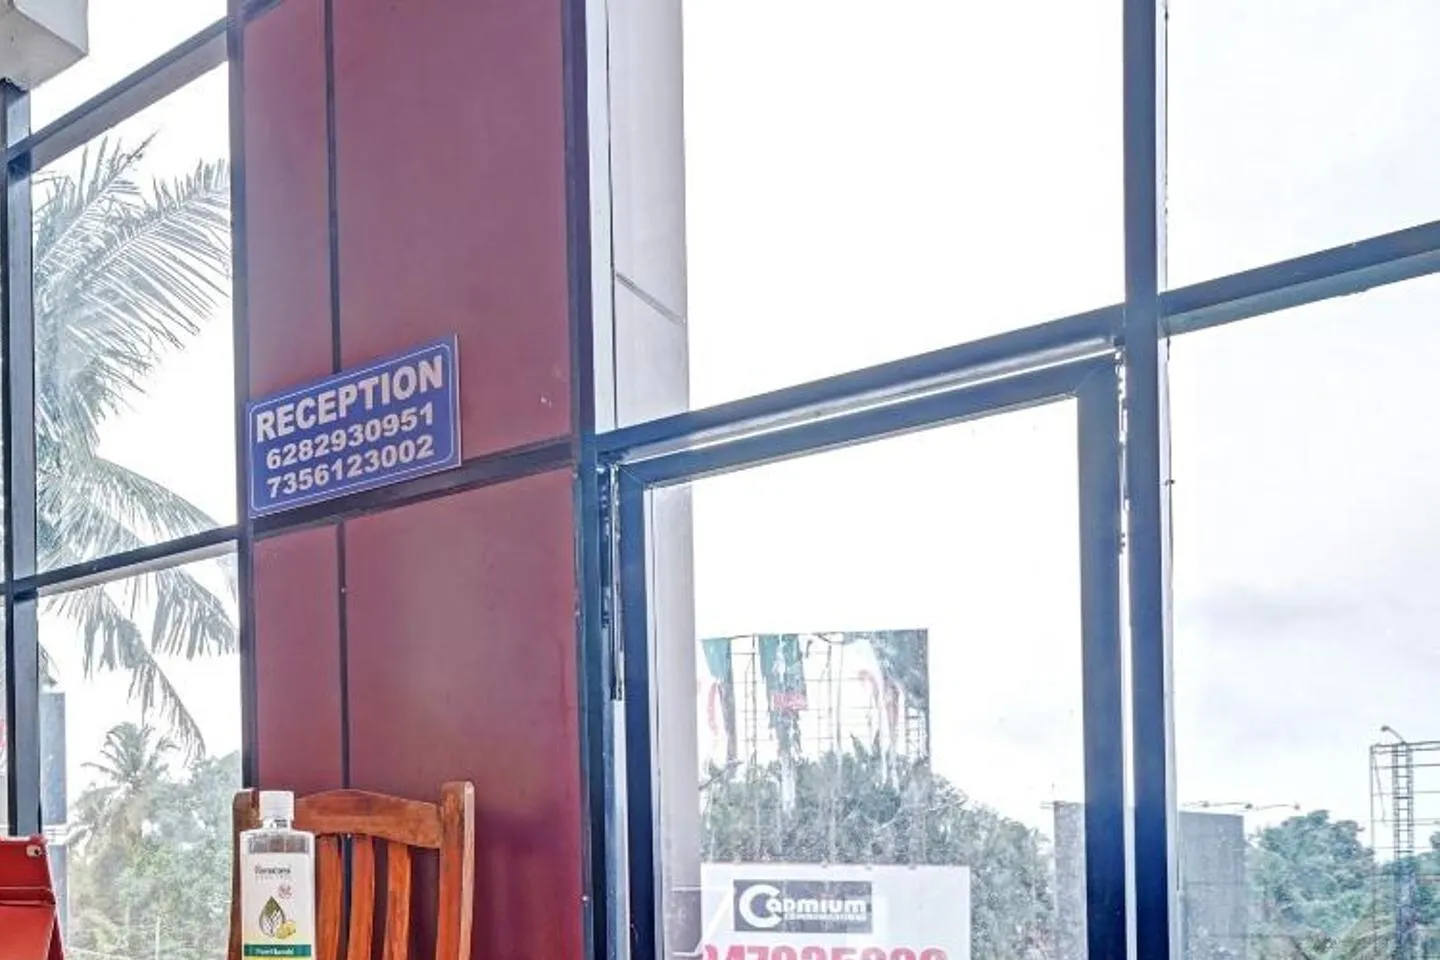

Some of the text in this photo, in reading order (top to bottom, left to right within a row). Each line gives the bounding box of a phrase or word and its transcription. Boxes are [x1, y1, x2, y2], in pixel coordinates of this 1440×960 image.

[256, 355, 444, 443] RECEPTION
[266, 402, 433, 470] 6282930951
[267, 435, 434, 499] 7356123002
